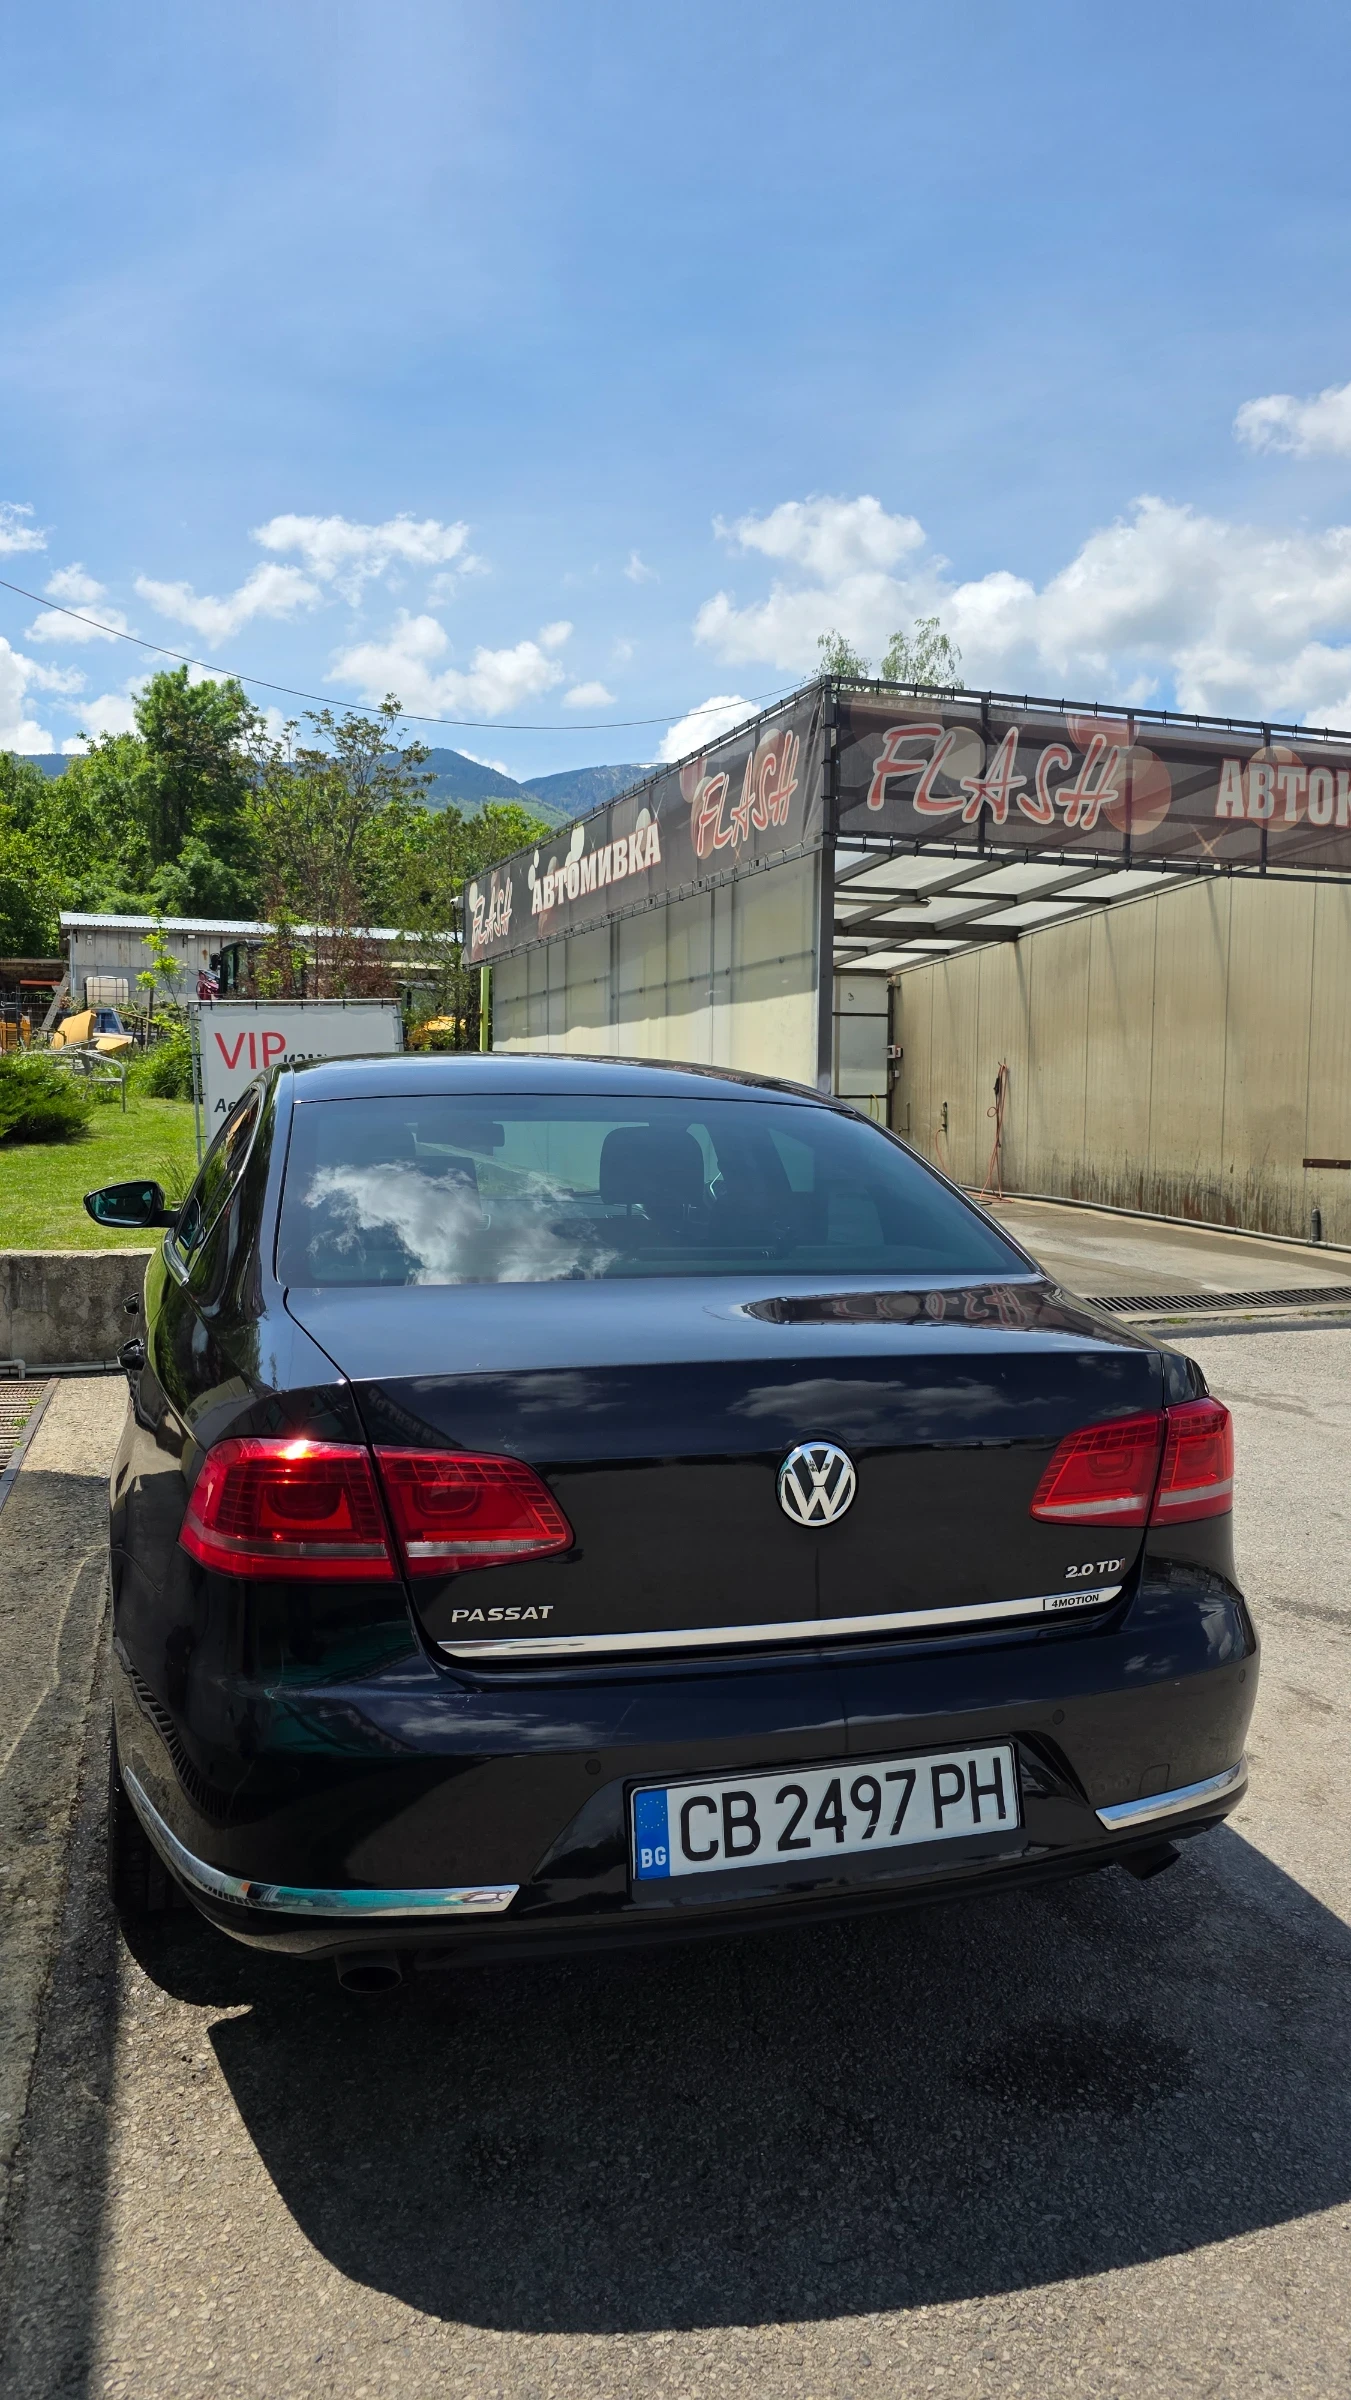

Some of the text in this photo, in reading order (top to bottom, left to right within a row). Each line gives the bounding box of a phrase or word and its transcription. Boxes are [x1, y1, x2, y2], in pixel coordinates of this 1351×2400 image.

[867, 721, 1124, 831] FLASH
[471, 729, 800, 948] FLASH АВТОМИВКА FLASH
[214, 1031, 286, 1069] VIP
[780, 1441, 857, 1527] VW
[1065, 1557, 1126, 1579] 2.0 TDI
[451, 1605, 554, 1623] PASSAT
[1051, 1593, 1100, 1608] 4MOTION
[680, 1757, 1006, 1862] CB 2497 PH
[640, 1846, 667, 1868] BG
